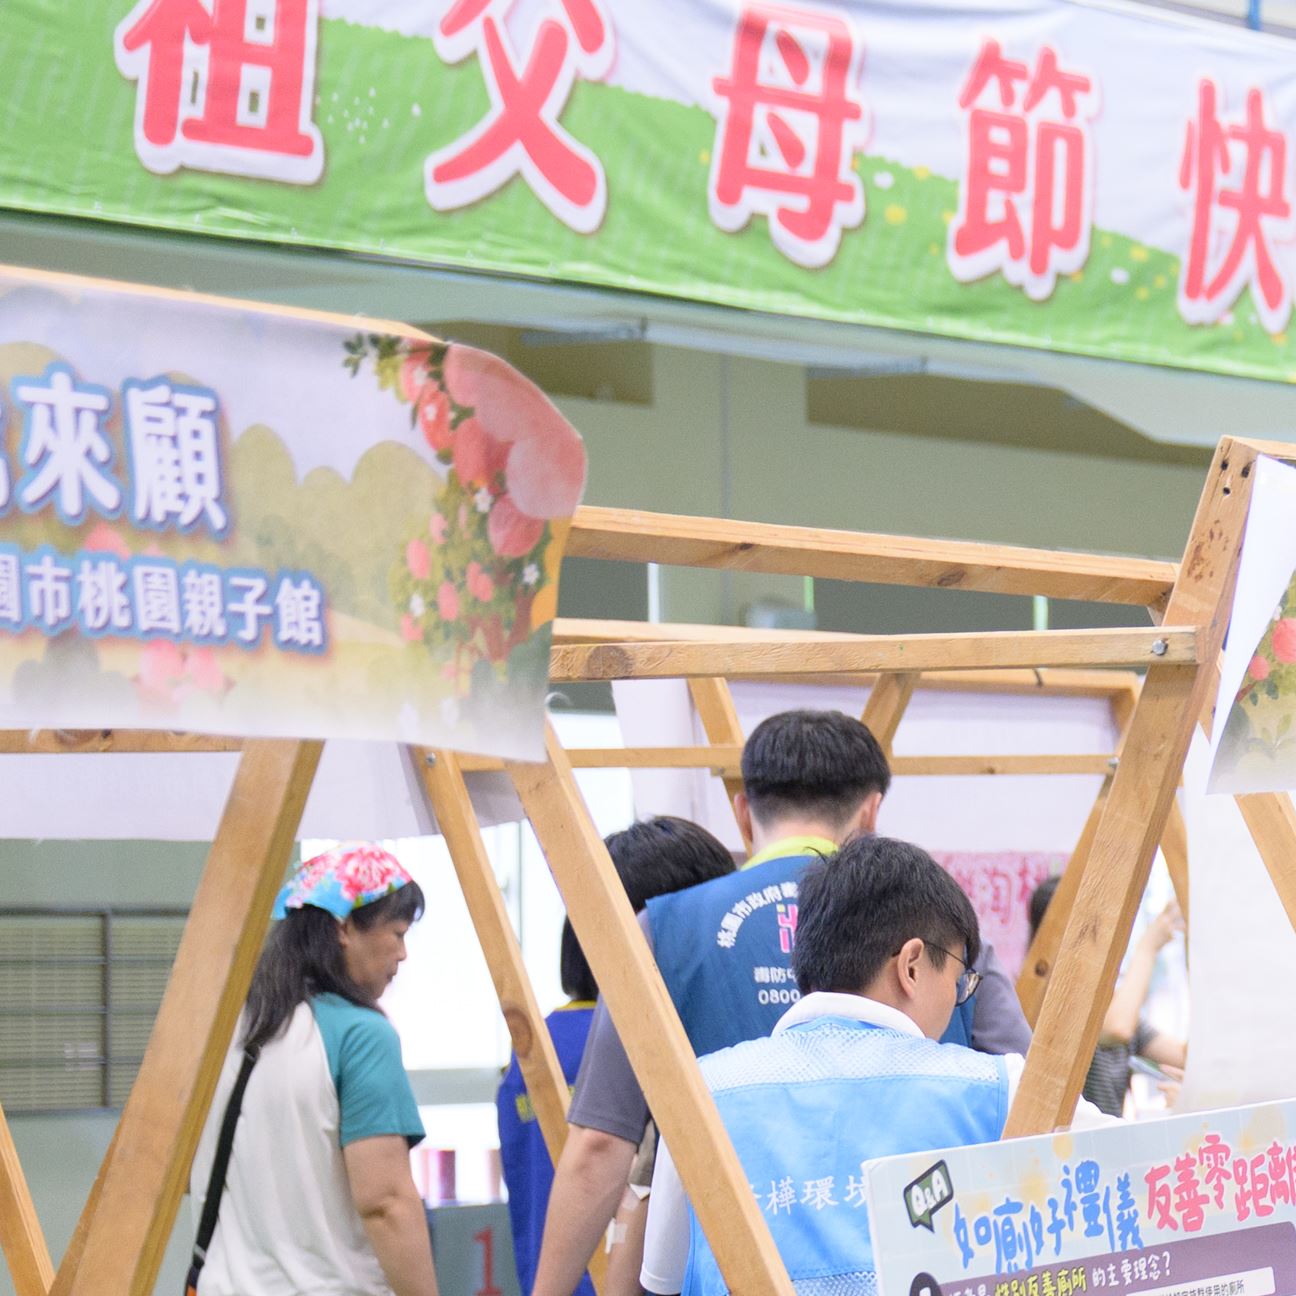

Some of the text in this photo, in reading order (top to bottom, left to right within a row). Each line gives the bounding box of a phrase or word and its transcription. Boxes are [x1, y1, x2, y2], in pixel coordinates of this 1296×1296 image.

[0, 371, 228, 531] 來顧
[758, 989, 801, 1005] 0800
[750, 1175, 867, 1216] 樺環
[910, 1174, 949, 1211] Q&A
